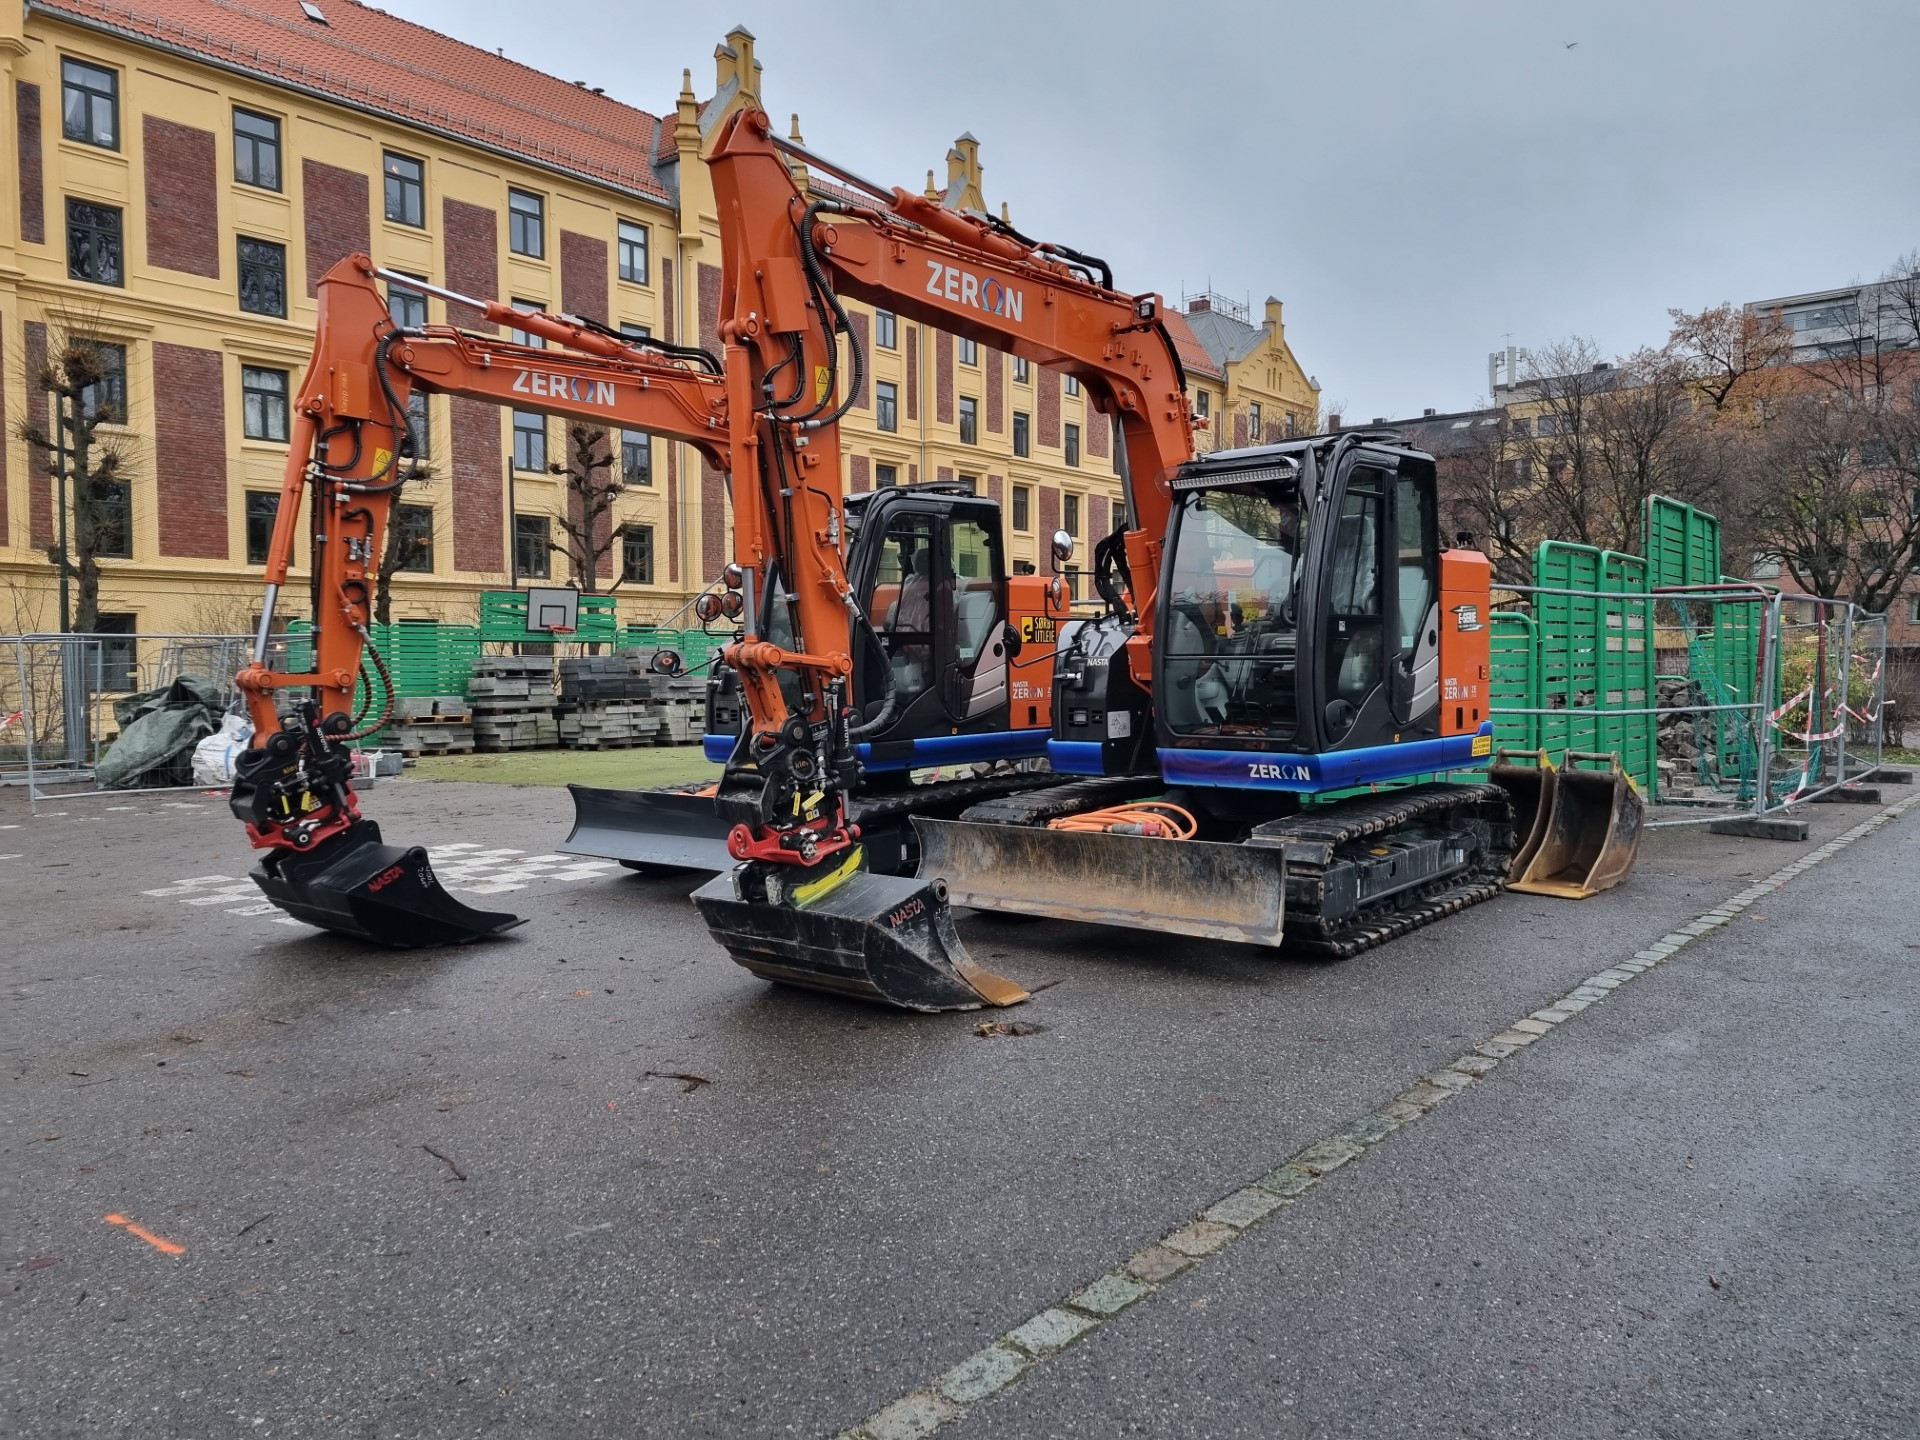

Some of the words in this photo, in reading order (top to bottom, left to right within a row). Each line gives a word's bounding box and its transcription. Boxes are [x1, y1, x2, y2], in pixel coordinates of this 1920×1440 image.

[1087, 658, 1109, 667] NASTA
[367, 864, 405, 893] NASTA
[888, 898, 926, 928] NASTA
